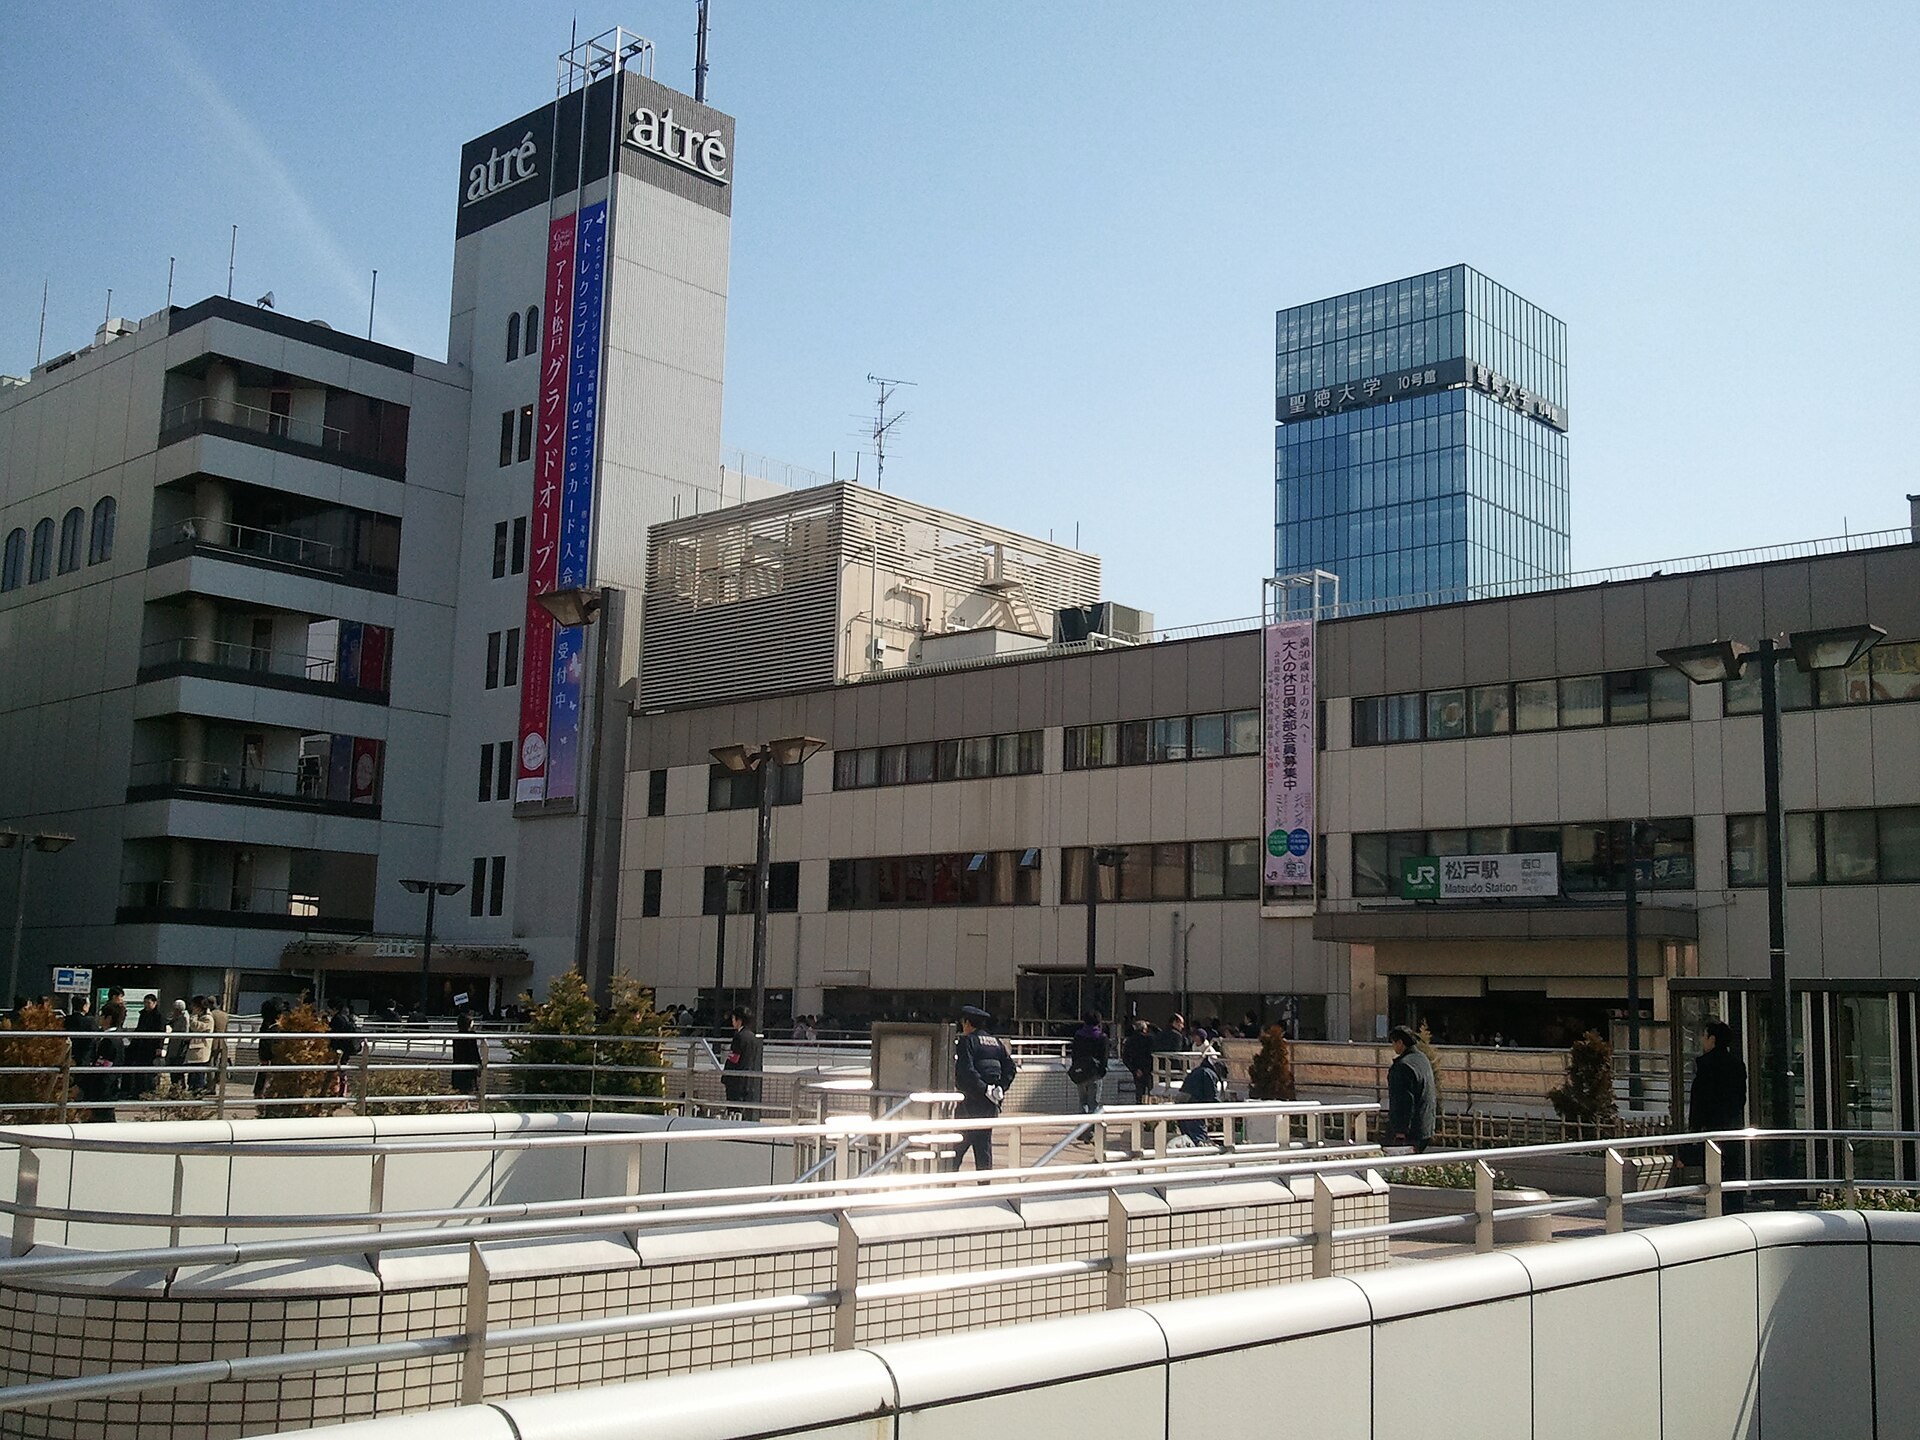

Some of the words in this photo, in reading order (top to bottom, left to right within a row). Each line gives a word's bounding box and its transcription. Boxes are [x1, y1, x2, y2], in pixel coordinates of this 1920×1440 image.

[466, 131, 537, 201] atré
[632, 107, 727, 176] atré
[1289, 378, 1382, 413] 聖徳大学
[1398, 369, 1437, 390] 10号館
[536, 260, 567, 595] アトレ松戸グランドオープン
[1282, 640, 1298, 790] 大人の休日倶楽部会員募集中
[1407, 866, 1435, 884] JR
[1445, 860, 1500, 880] 松戸駅
[1521, 858, 1542, 869] 西口
[1445, 883, 1483, 894] Matsudo
[1486, 882, 1518, 893] Station
